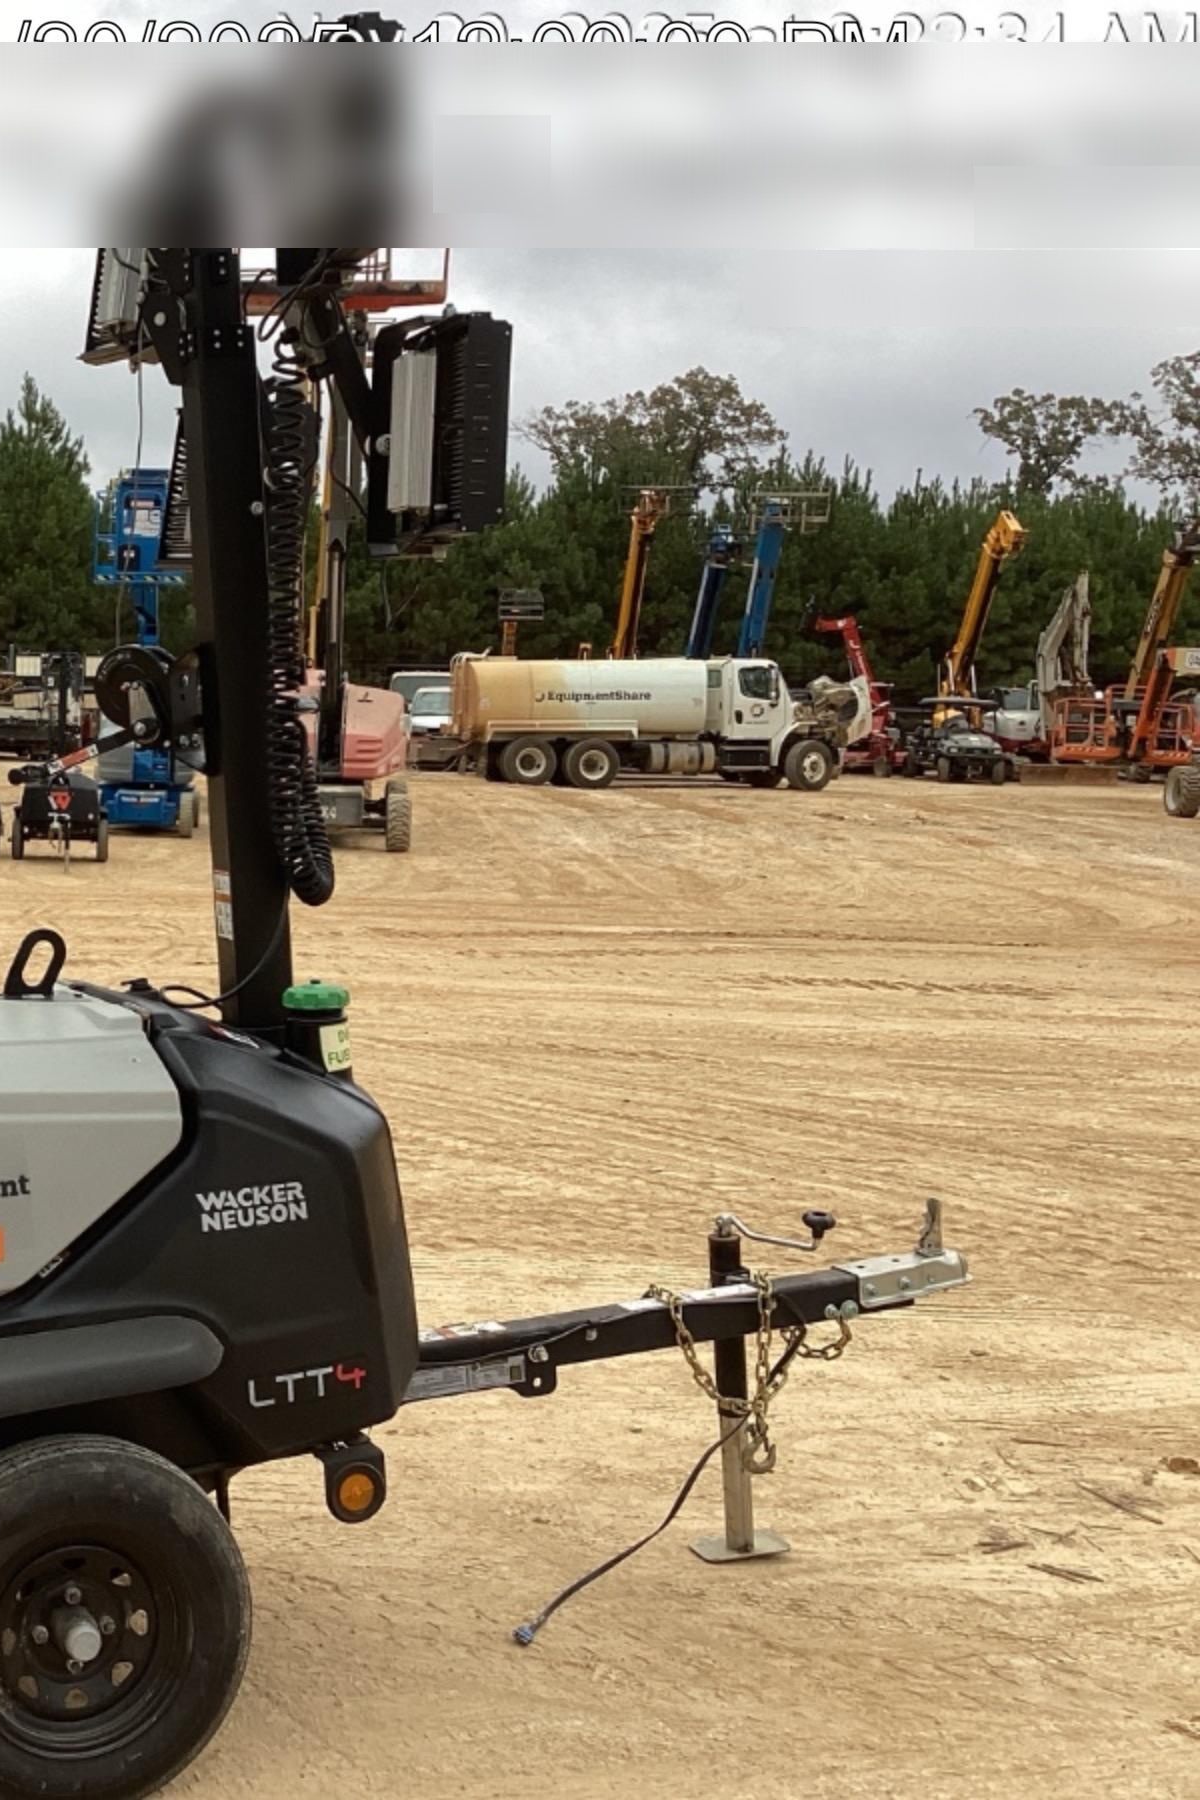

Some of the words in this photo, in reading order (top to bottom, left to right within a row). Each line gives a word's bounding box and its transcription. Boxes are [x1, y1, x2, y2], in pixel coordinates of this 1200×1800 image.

[195, 1181, 305, 1211] WACKER
[201, 1201, 308, 1232] NEUSON
[247, 1363, 366, 1408] LTT4
